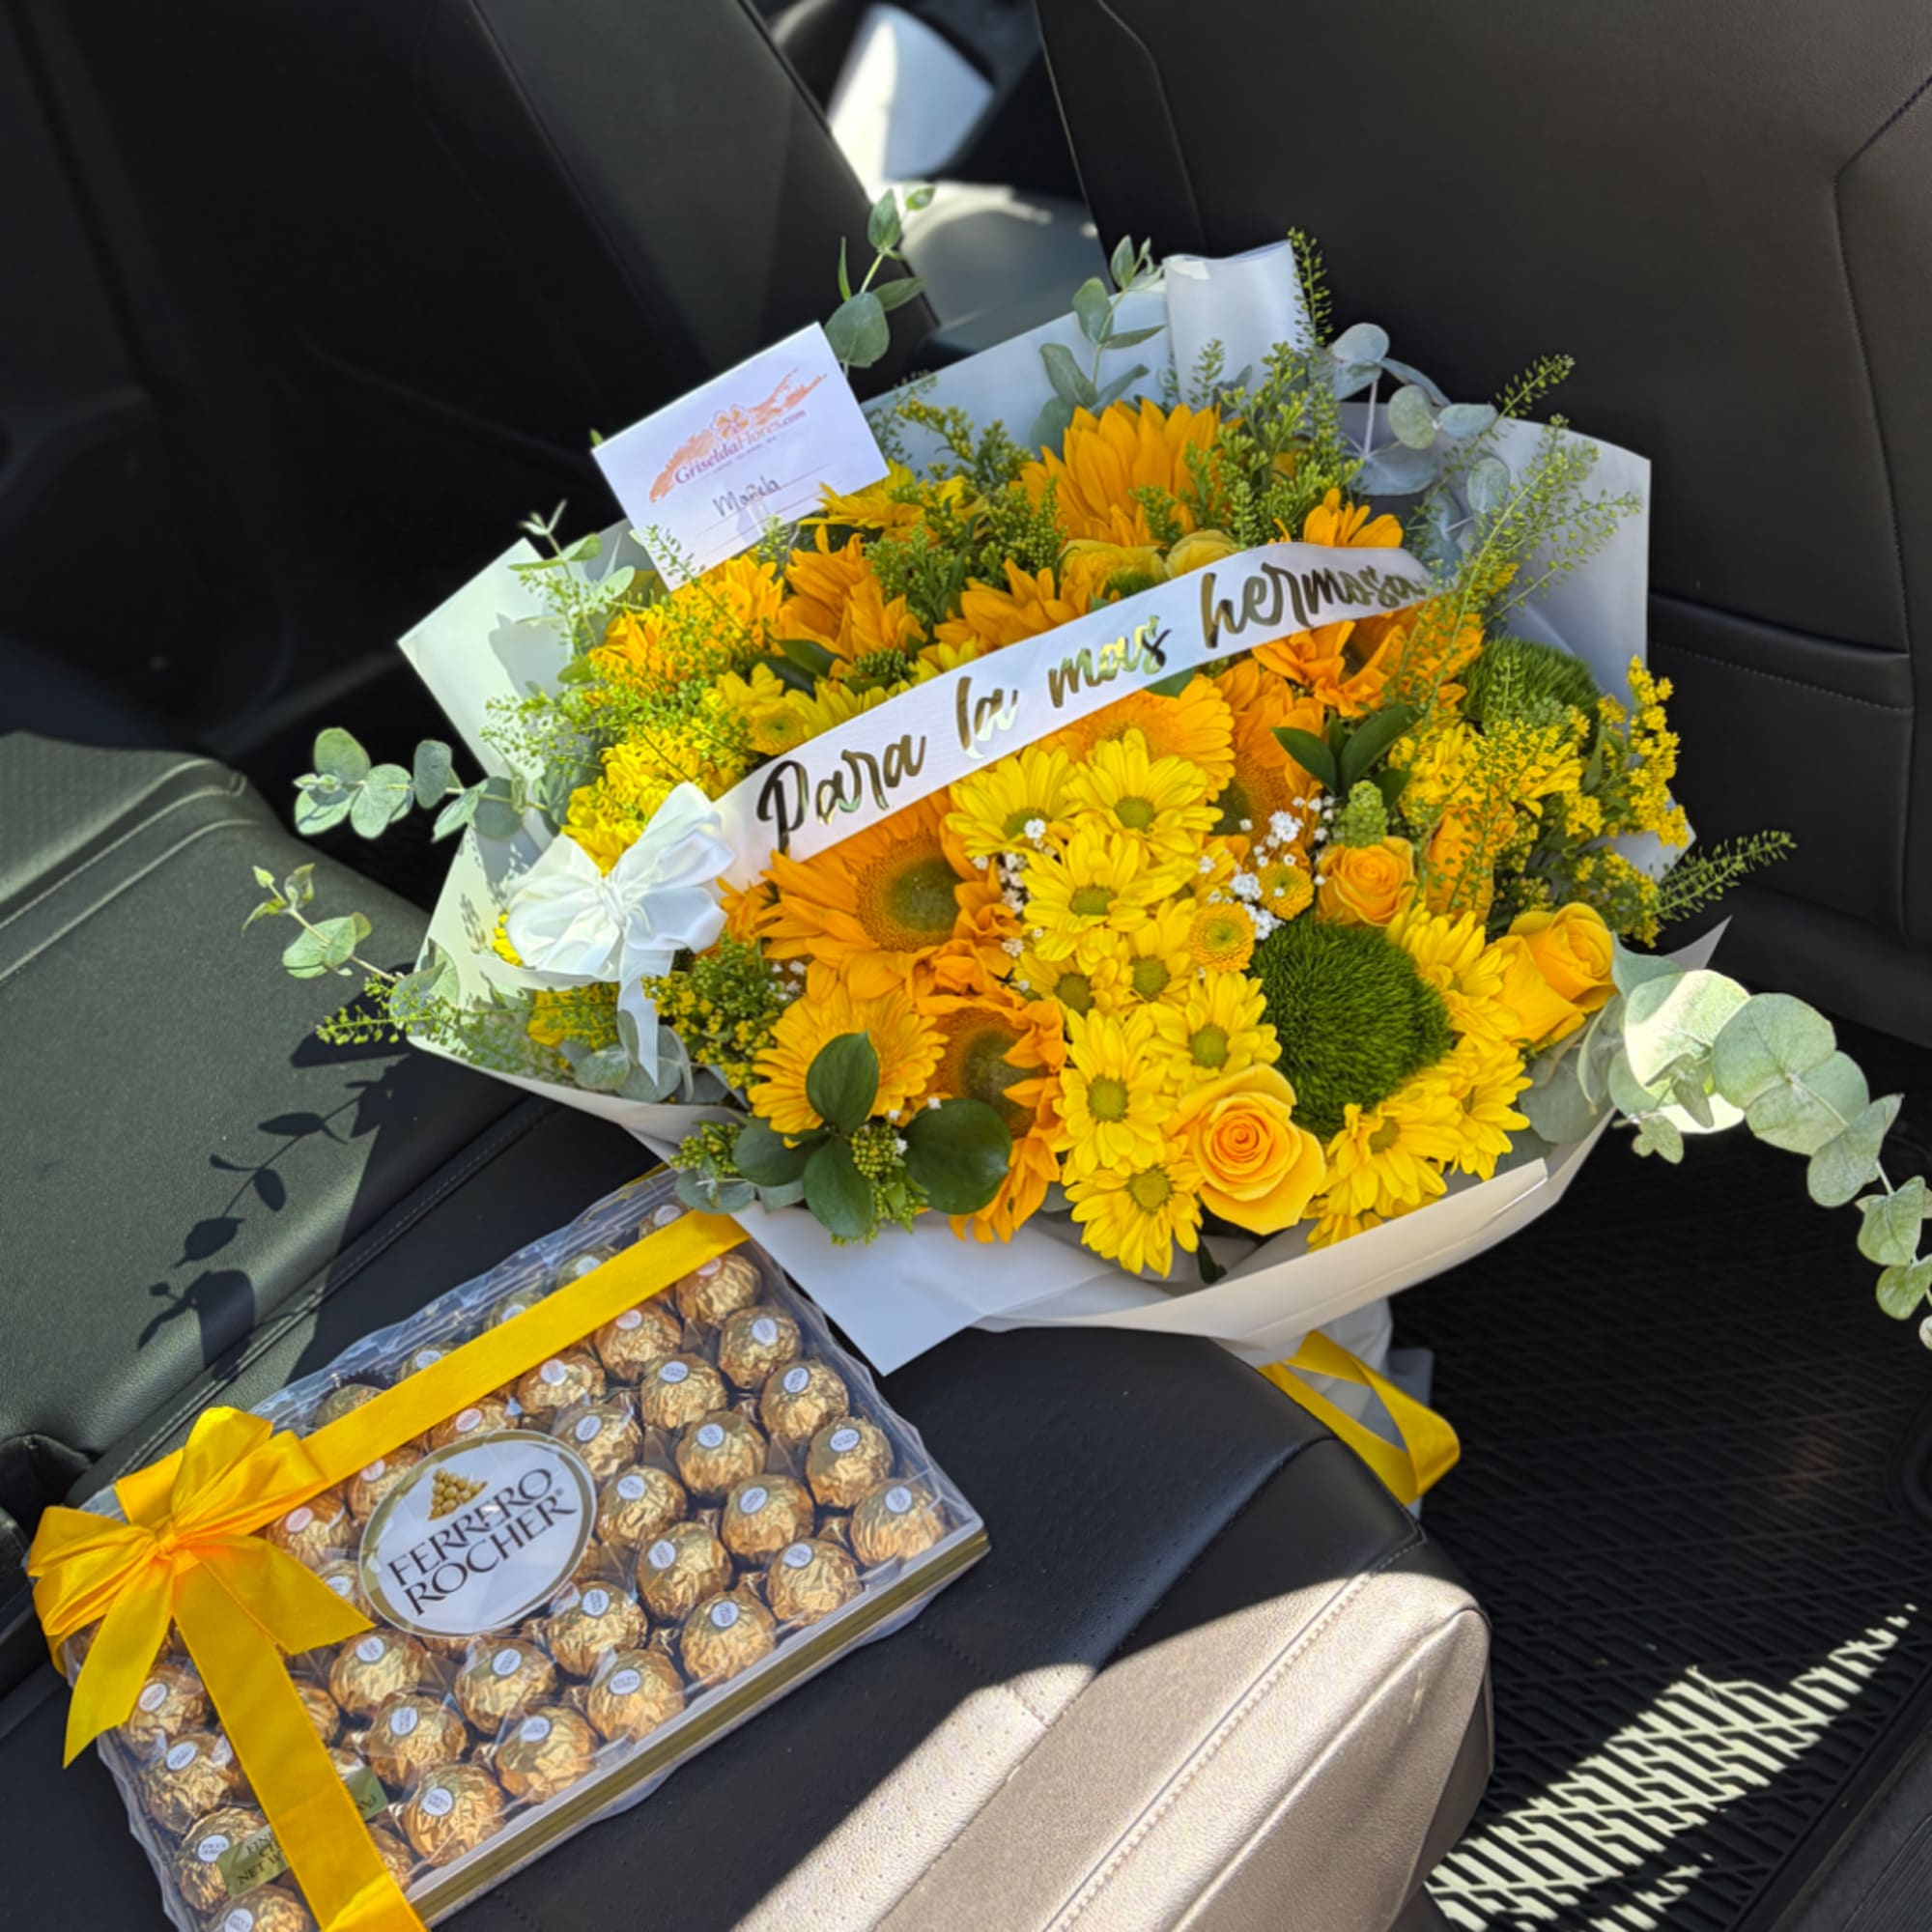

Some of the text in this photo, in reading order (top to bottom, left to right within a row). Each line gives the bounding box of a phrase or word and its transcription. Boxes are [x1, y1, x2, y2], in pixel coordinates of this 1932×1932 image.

[756, 562, 1427, 854] Para la mas hermosa
[387, 1468, 553, 1586] FERRERO
[404, 1494, 578, 1616] ROCHER
